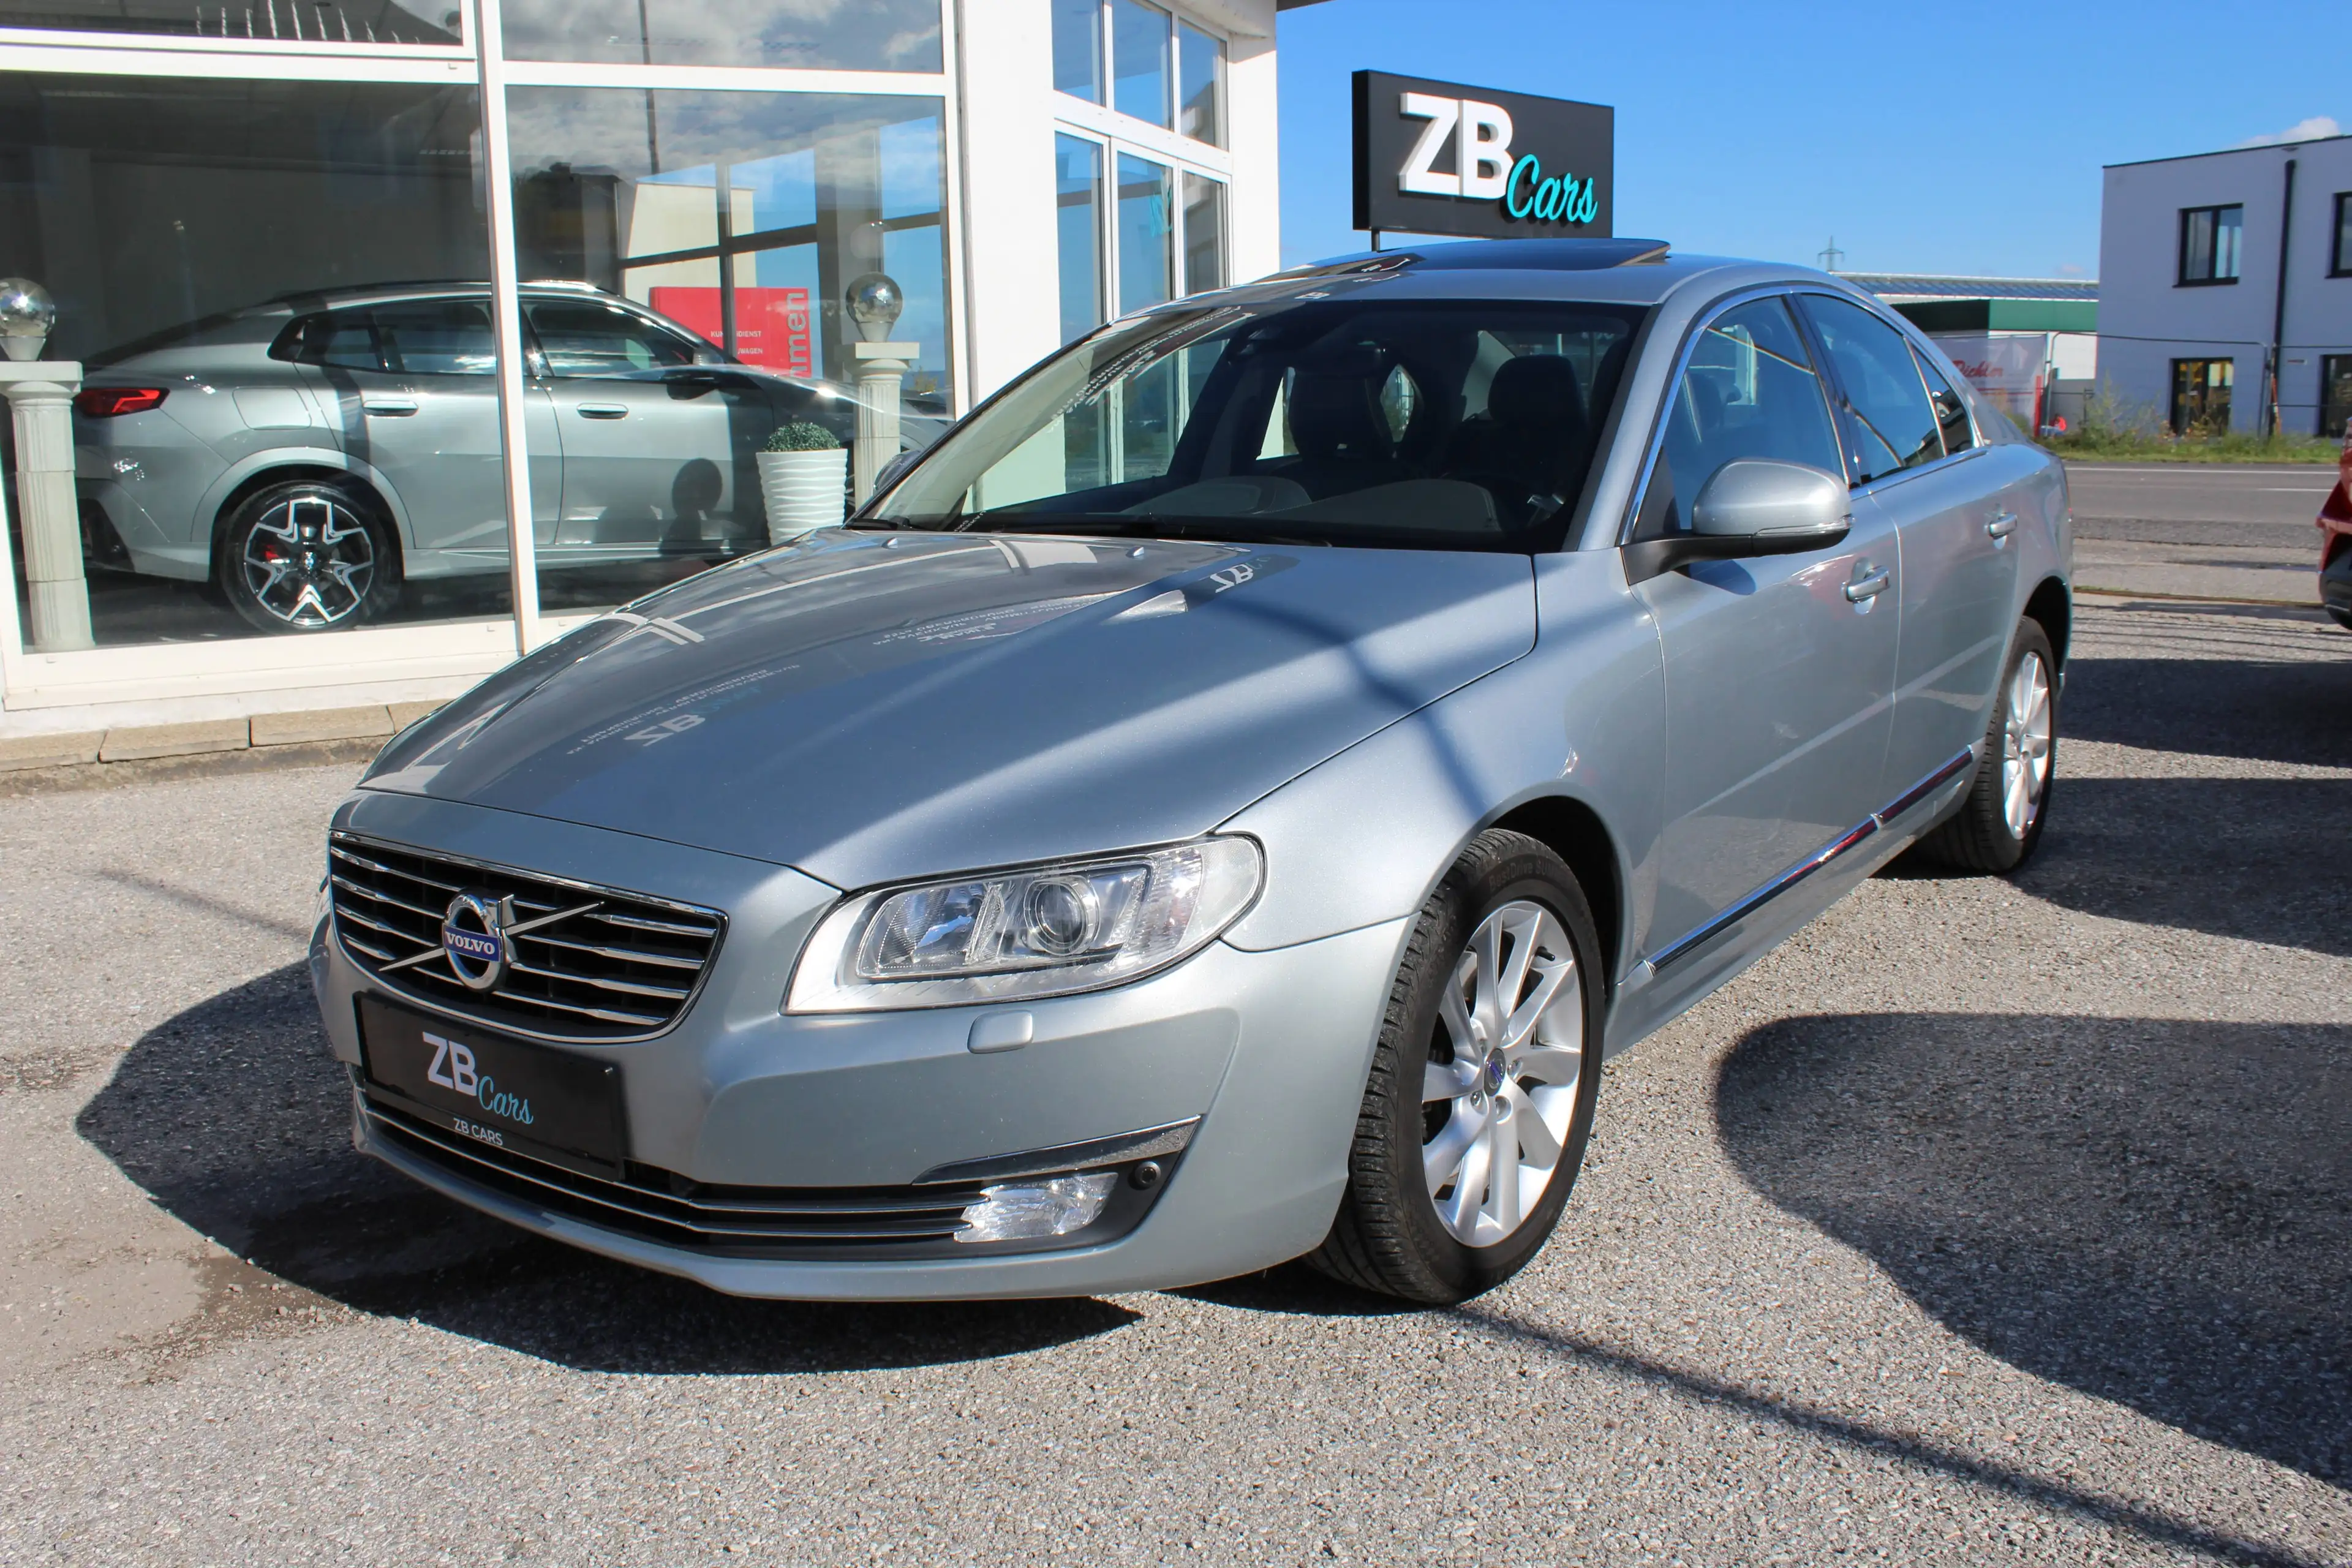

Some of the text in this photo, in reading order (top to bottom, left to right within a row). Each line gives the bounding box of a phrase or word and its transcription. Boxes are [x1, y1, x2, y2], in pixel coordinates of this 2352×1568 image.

[1398, 92, 1598, 223] ZB Cars
[787, 293, 807, 377] mmen
[445, 931, 495, 954] VOLVO
[423, 1031, 534, 1125] ZB Cars
[453, 1118, 503, 1146] ZB CARS
